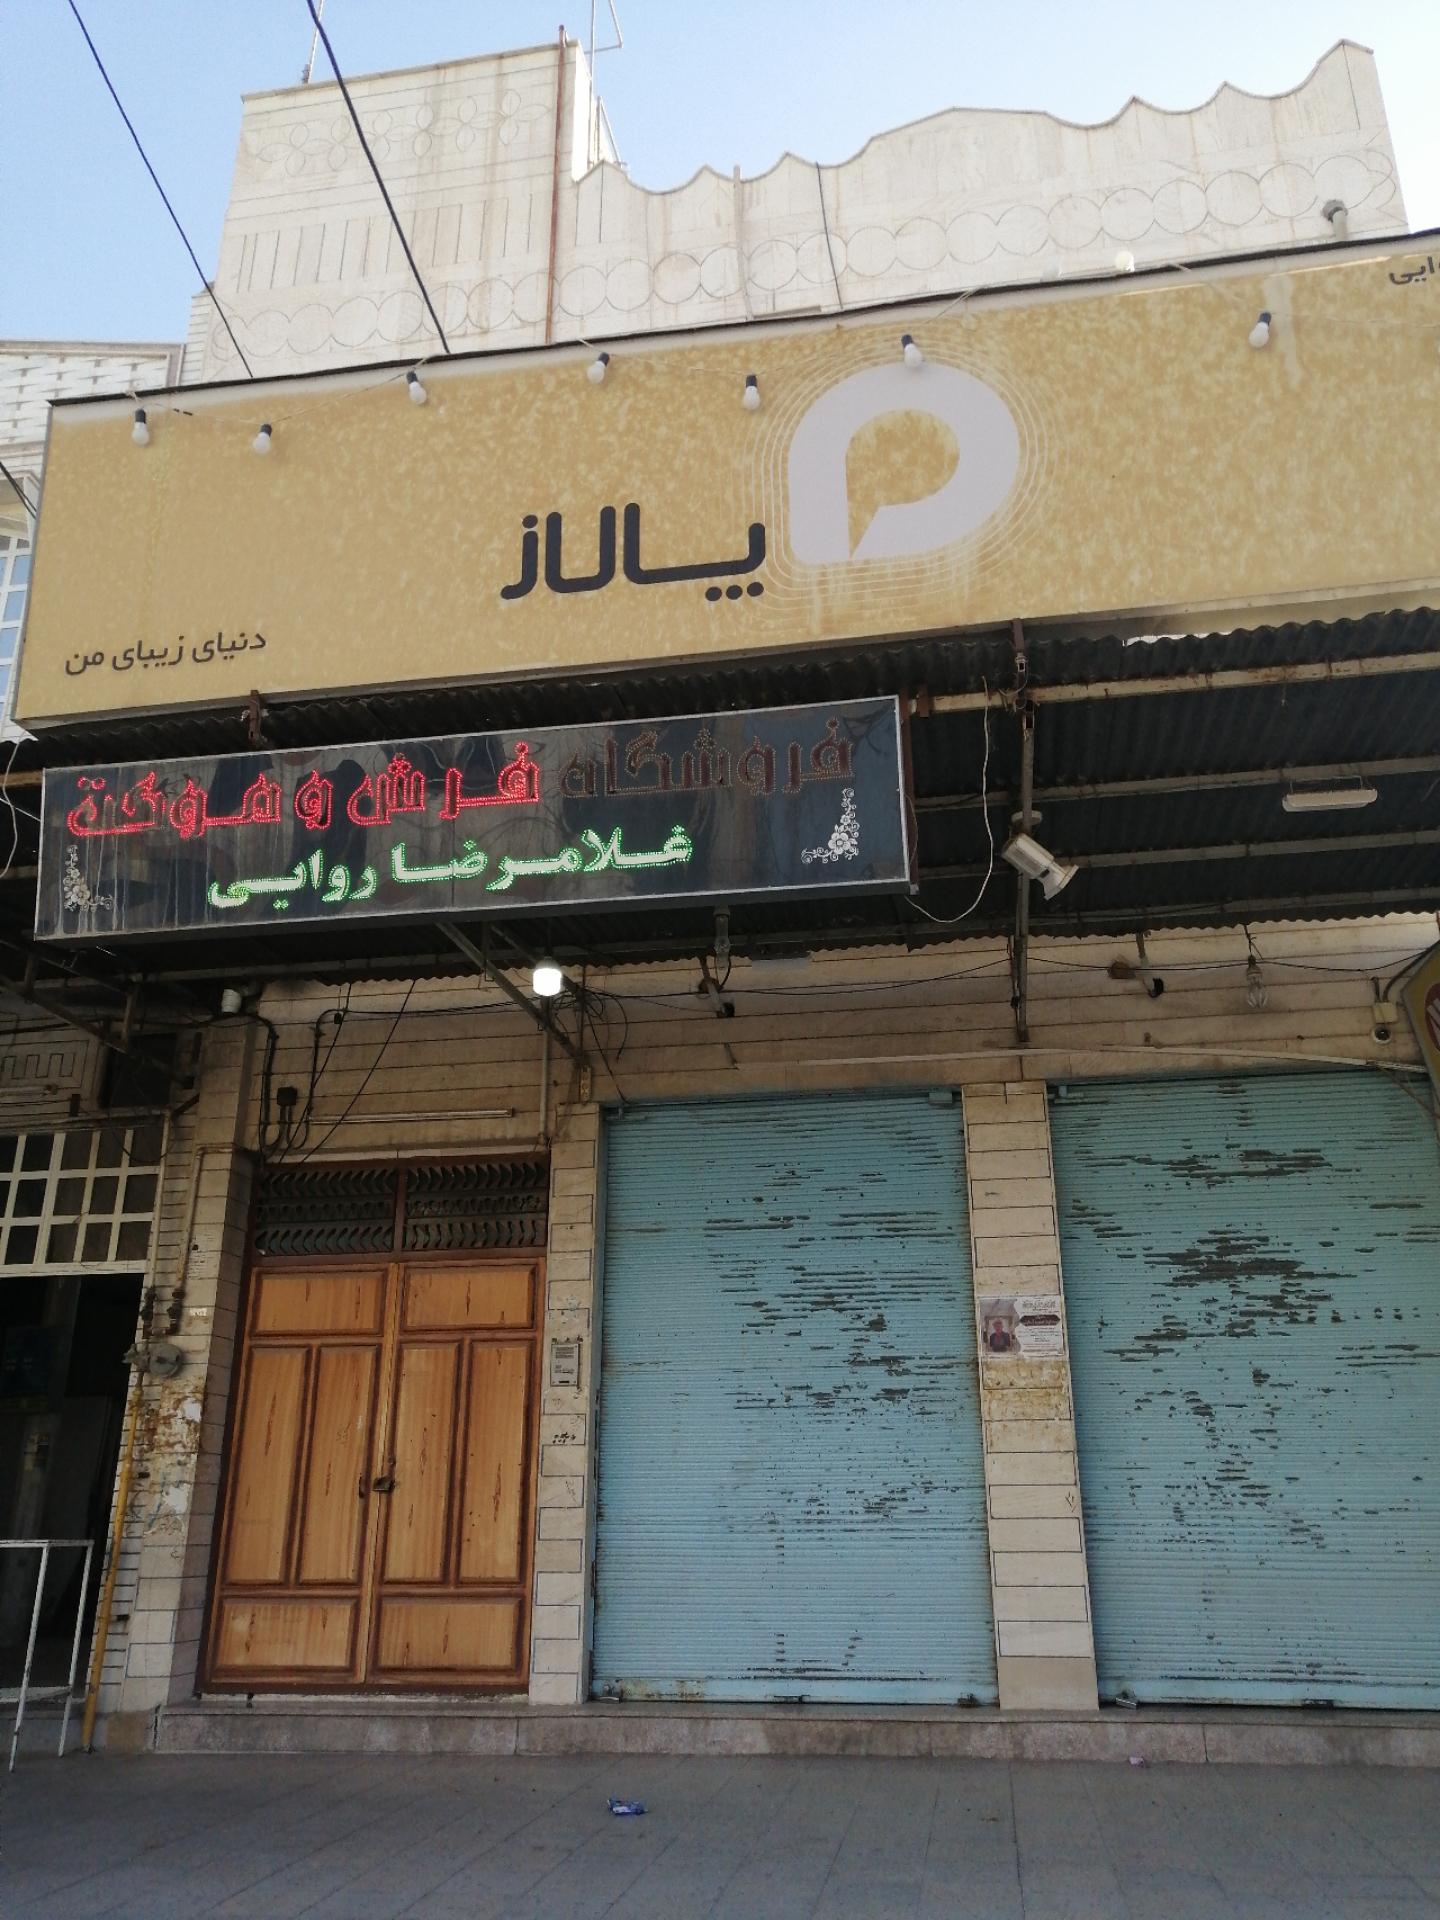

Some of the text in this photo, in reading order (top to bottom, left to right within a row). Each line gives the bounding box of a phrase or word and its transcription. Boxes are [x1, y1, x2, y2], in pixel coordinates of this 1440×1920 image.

[501, 502, 766, 601] پالاز
[65, 631, 267, 675] دنیای زیبای من
[67, 716, 854, 839] فروشگاه فرش و موکت
[207, 825, 694, 910] غلامرضا روایی
